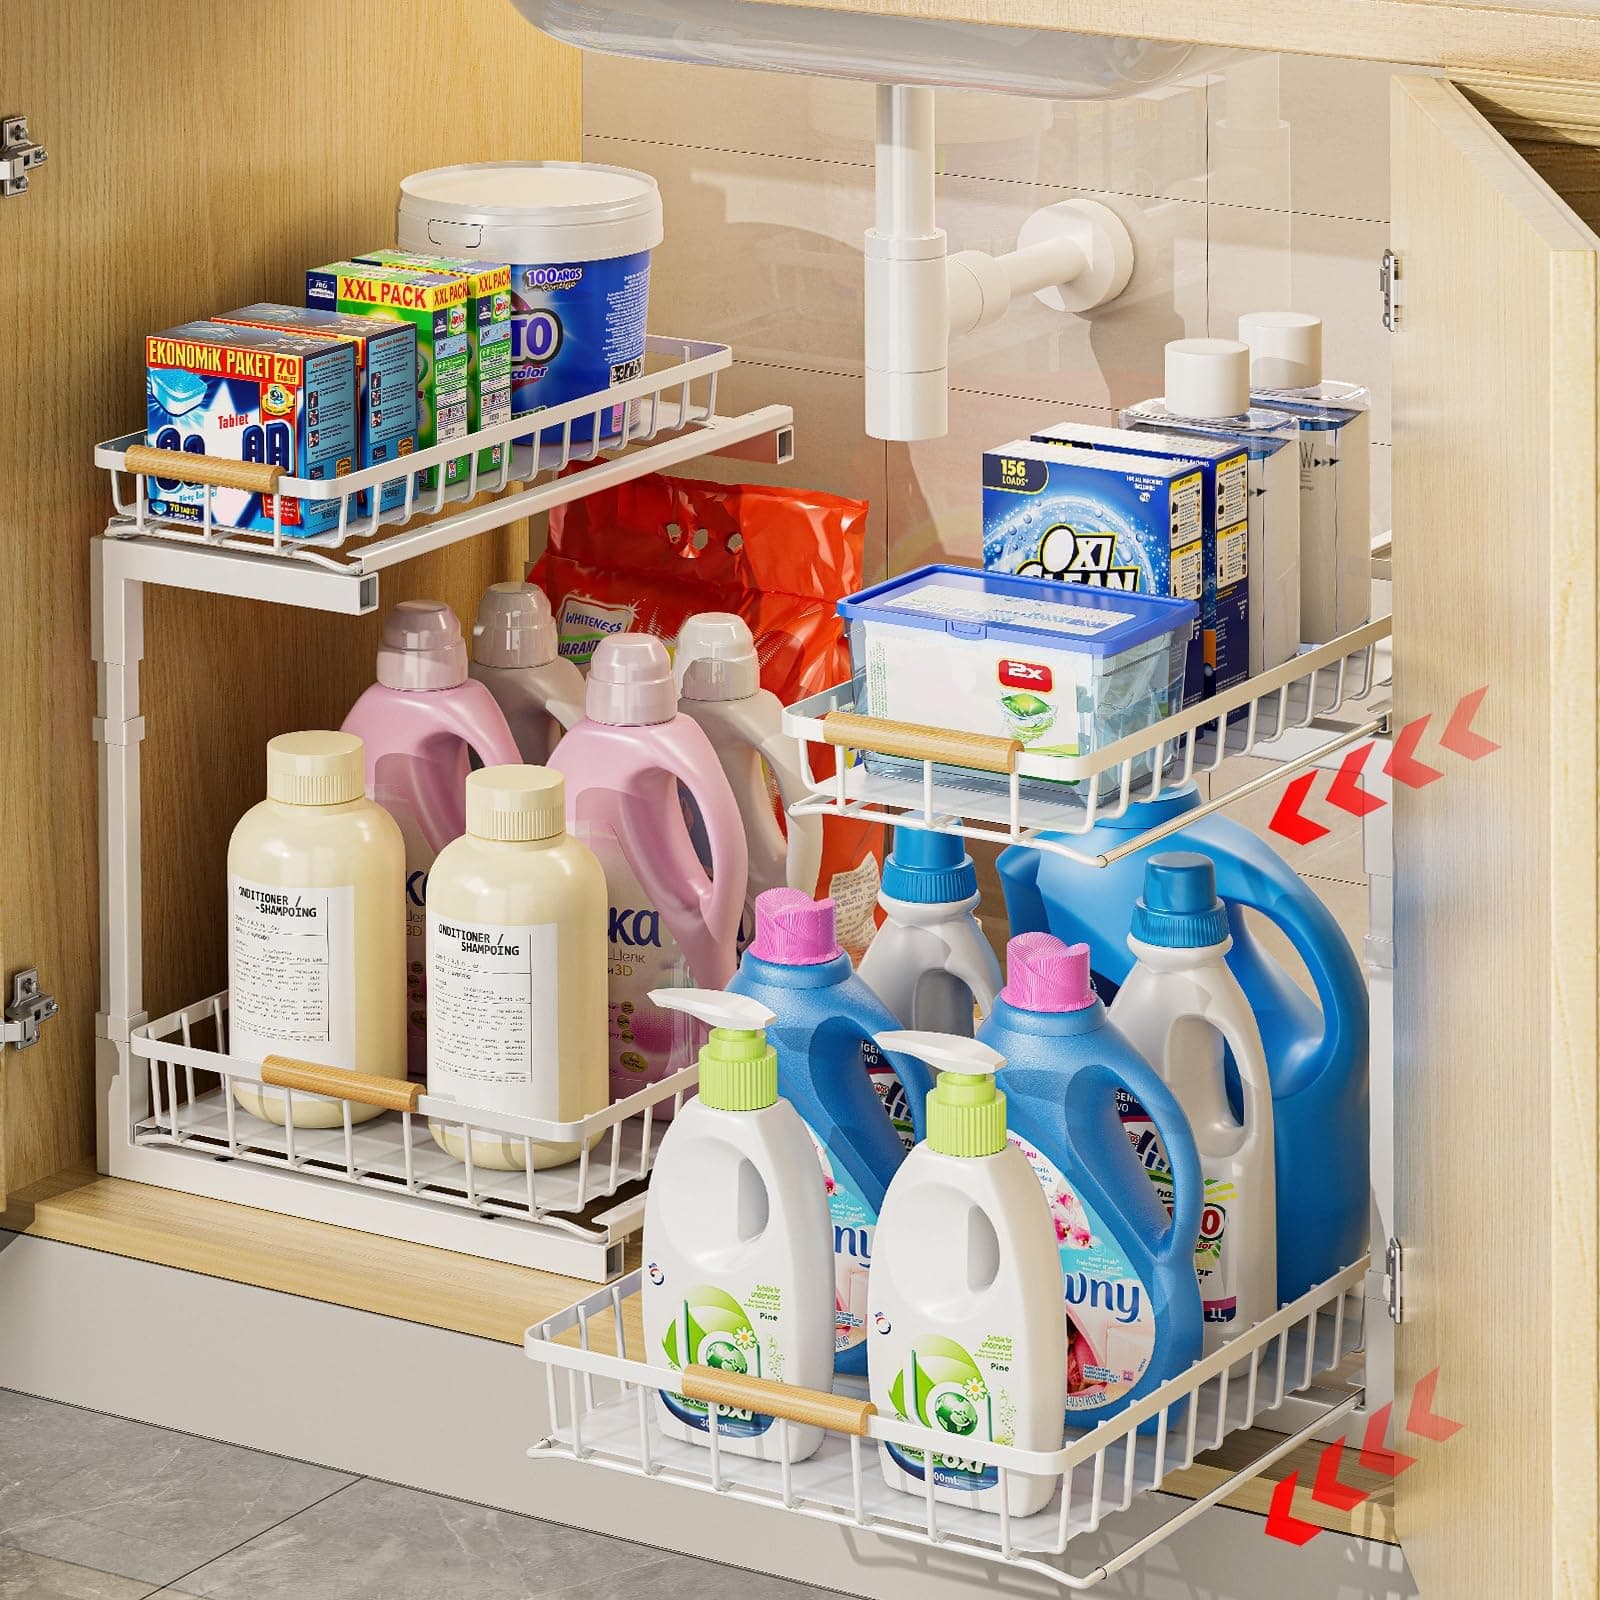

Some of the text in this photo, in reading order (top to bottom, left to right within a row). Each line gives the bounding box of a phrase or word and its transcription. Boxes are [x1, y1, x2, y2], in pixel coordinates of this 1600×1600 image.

[478, 267, 511, 293] XXL PACK
[342, 277, 427, 309] XXL PACK
[434, 279, 468, 306] XXL PACK
[226, 349, 272, 379] PAKET
[276, 357, 297, 376] 70
[512, 366, 548, 380] color
[218, 414, 249, 430] Tablet
[1000, 459, 1026, 477] 156
[1041, 526, 1112, 573] OXI
[565, 611, 623, 634] WHITENESS
[558, 638, 601, 656] UARANT
[461, 941, 520, 956] SHAMPOING
[1065, 1272, 1140, 1324] wny
[759, 1312, 778, 1322] Pine
[990, 1362, 1010, 1373] Pine
[942, 1455, 985, 1475] OXI
